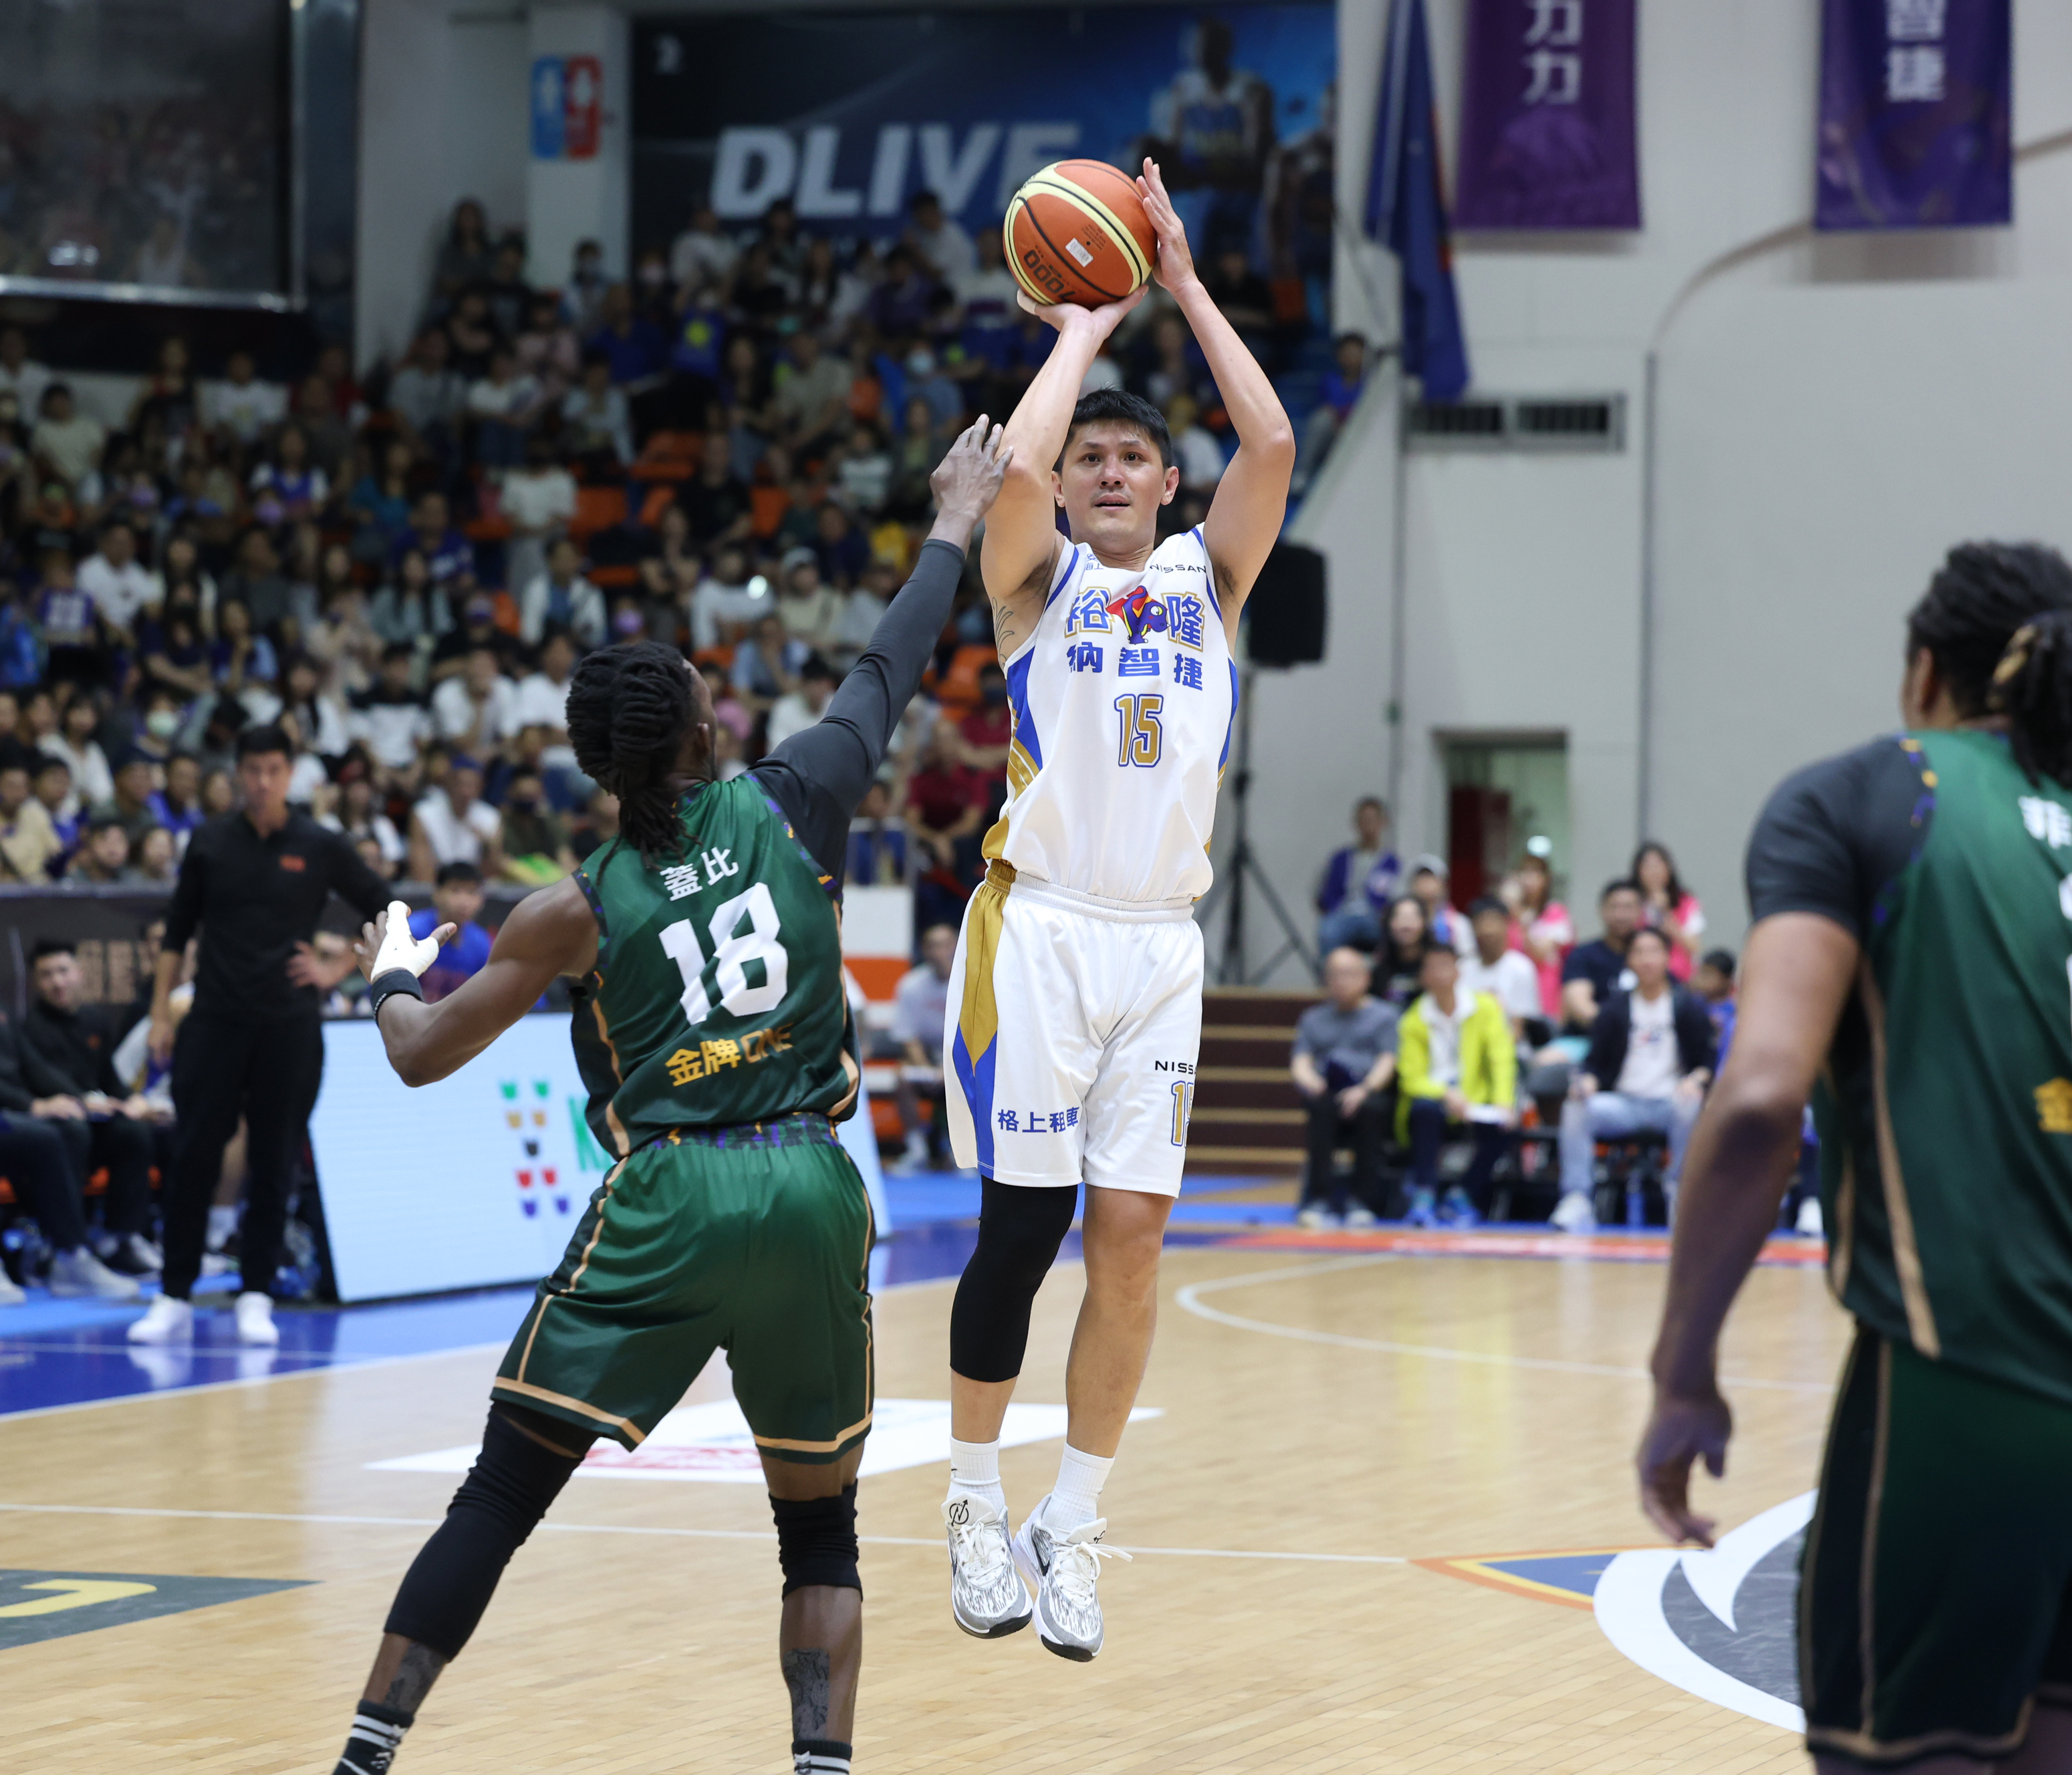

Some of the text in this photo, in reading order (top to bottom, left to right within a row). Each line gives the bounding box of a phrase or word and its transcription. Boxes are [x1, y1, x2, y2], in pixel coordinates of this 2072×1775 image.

[1150, 563, 1206, 573] NISSAN
[1066, 642, 1203, 691] 納智捷
[1114, 693, 1164, 768] 15
[660, 846, 739, 902] 蓋比
[658, 881, 788, 1026] 18
[1155, 1060, 1197, 1075] NISS
[998, 1106, 1080, 1133] 格上租車
